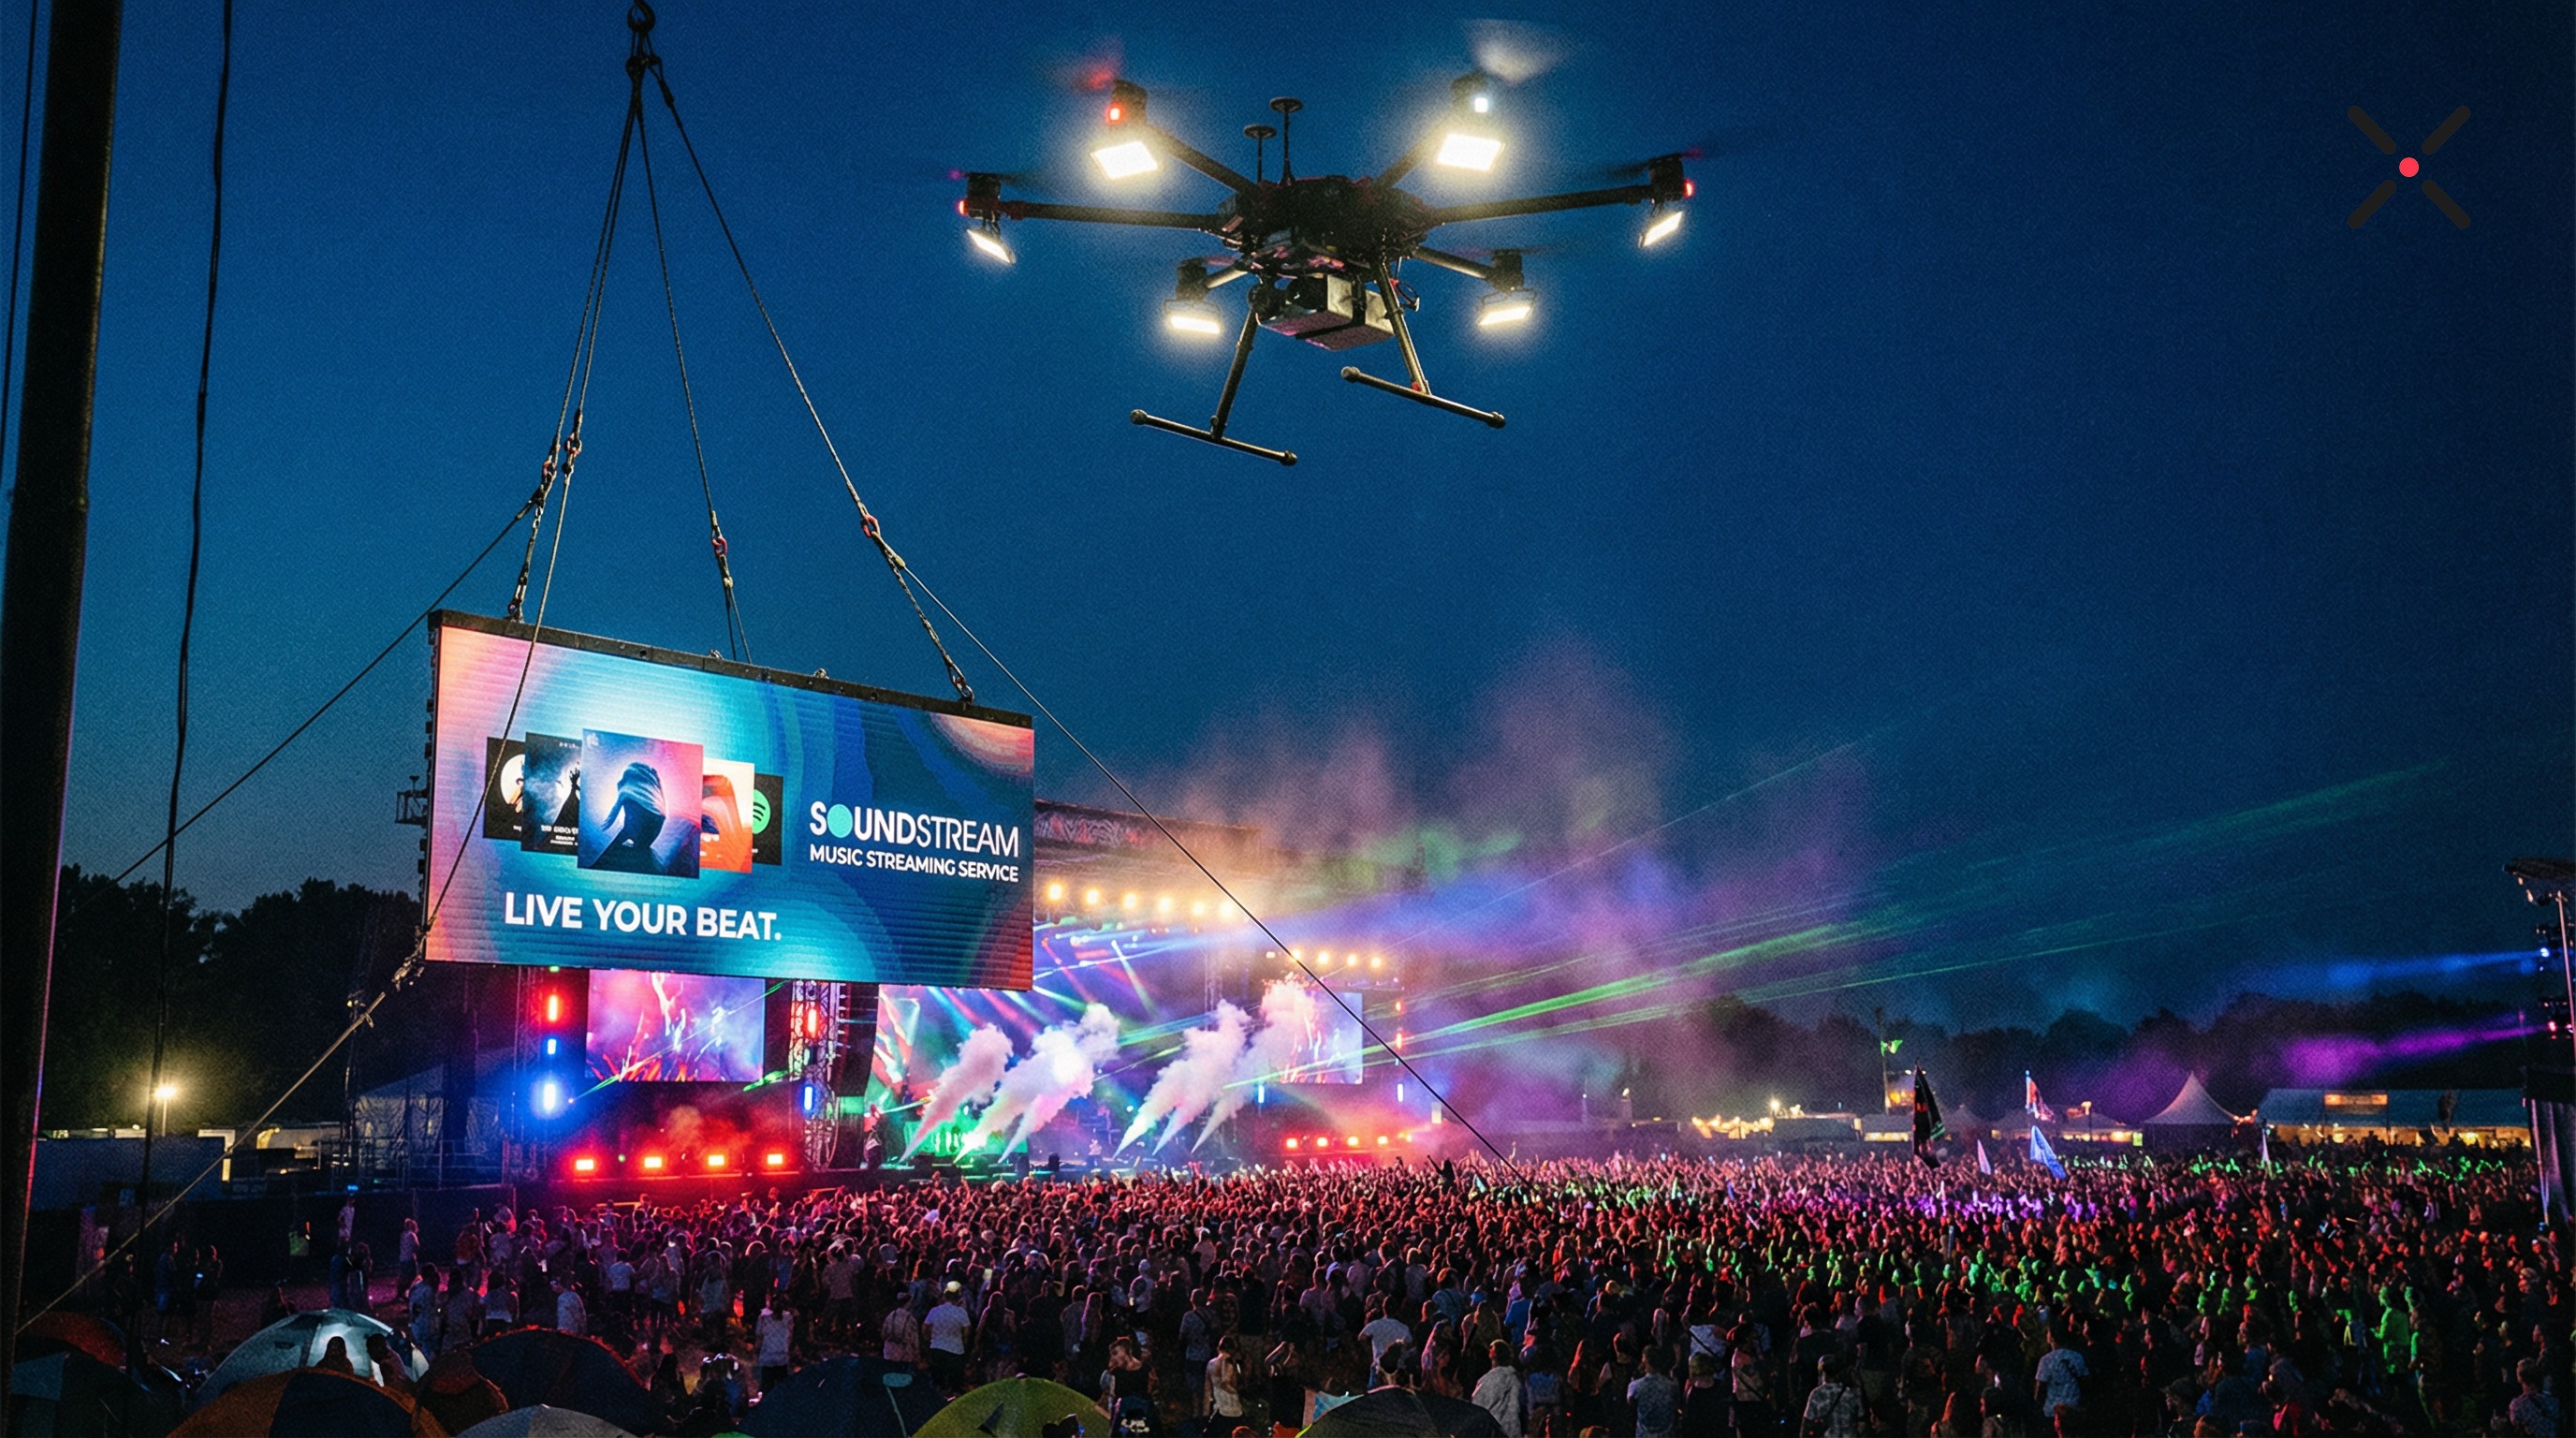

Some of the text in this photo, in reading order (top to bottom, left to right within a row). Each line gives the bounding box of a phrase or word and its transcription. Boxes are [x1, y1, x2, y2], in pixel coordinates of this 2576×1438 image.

[810, 800, 1019, 858] SOUNDSTREAM
[810, 844, 1019, 883] MUSIC STREAMING SERVICE
[505, 892, 783, 941] LIVE YOUR BEAT.
